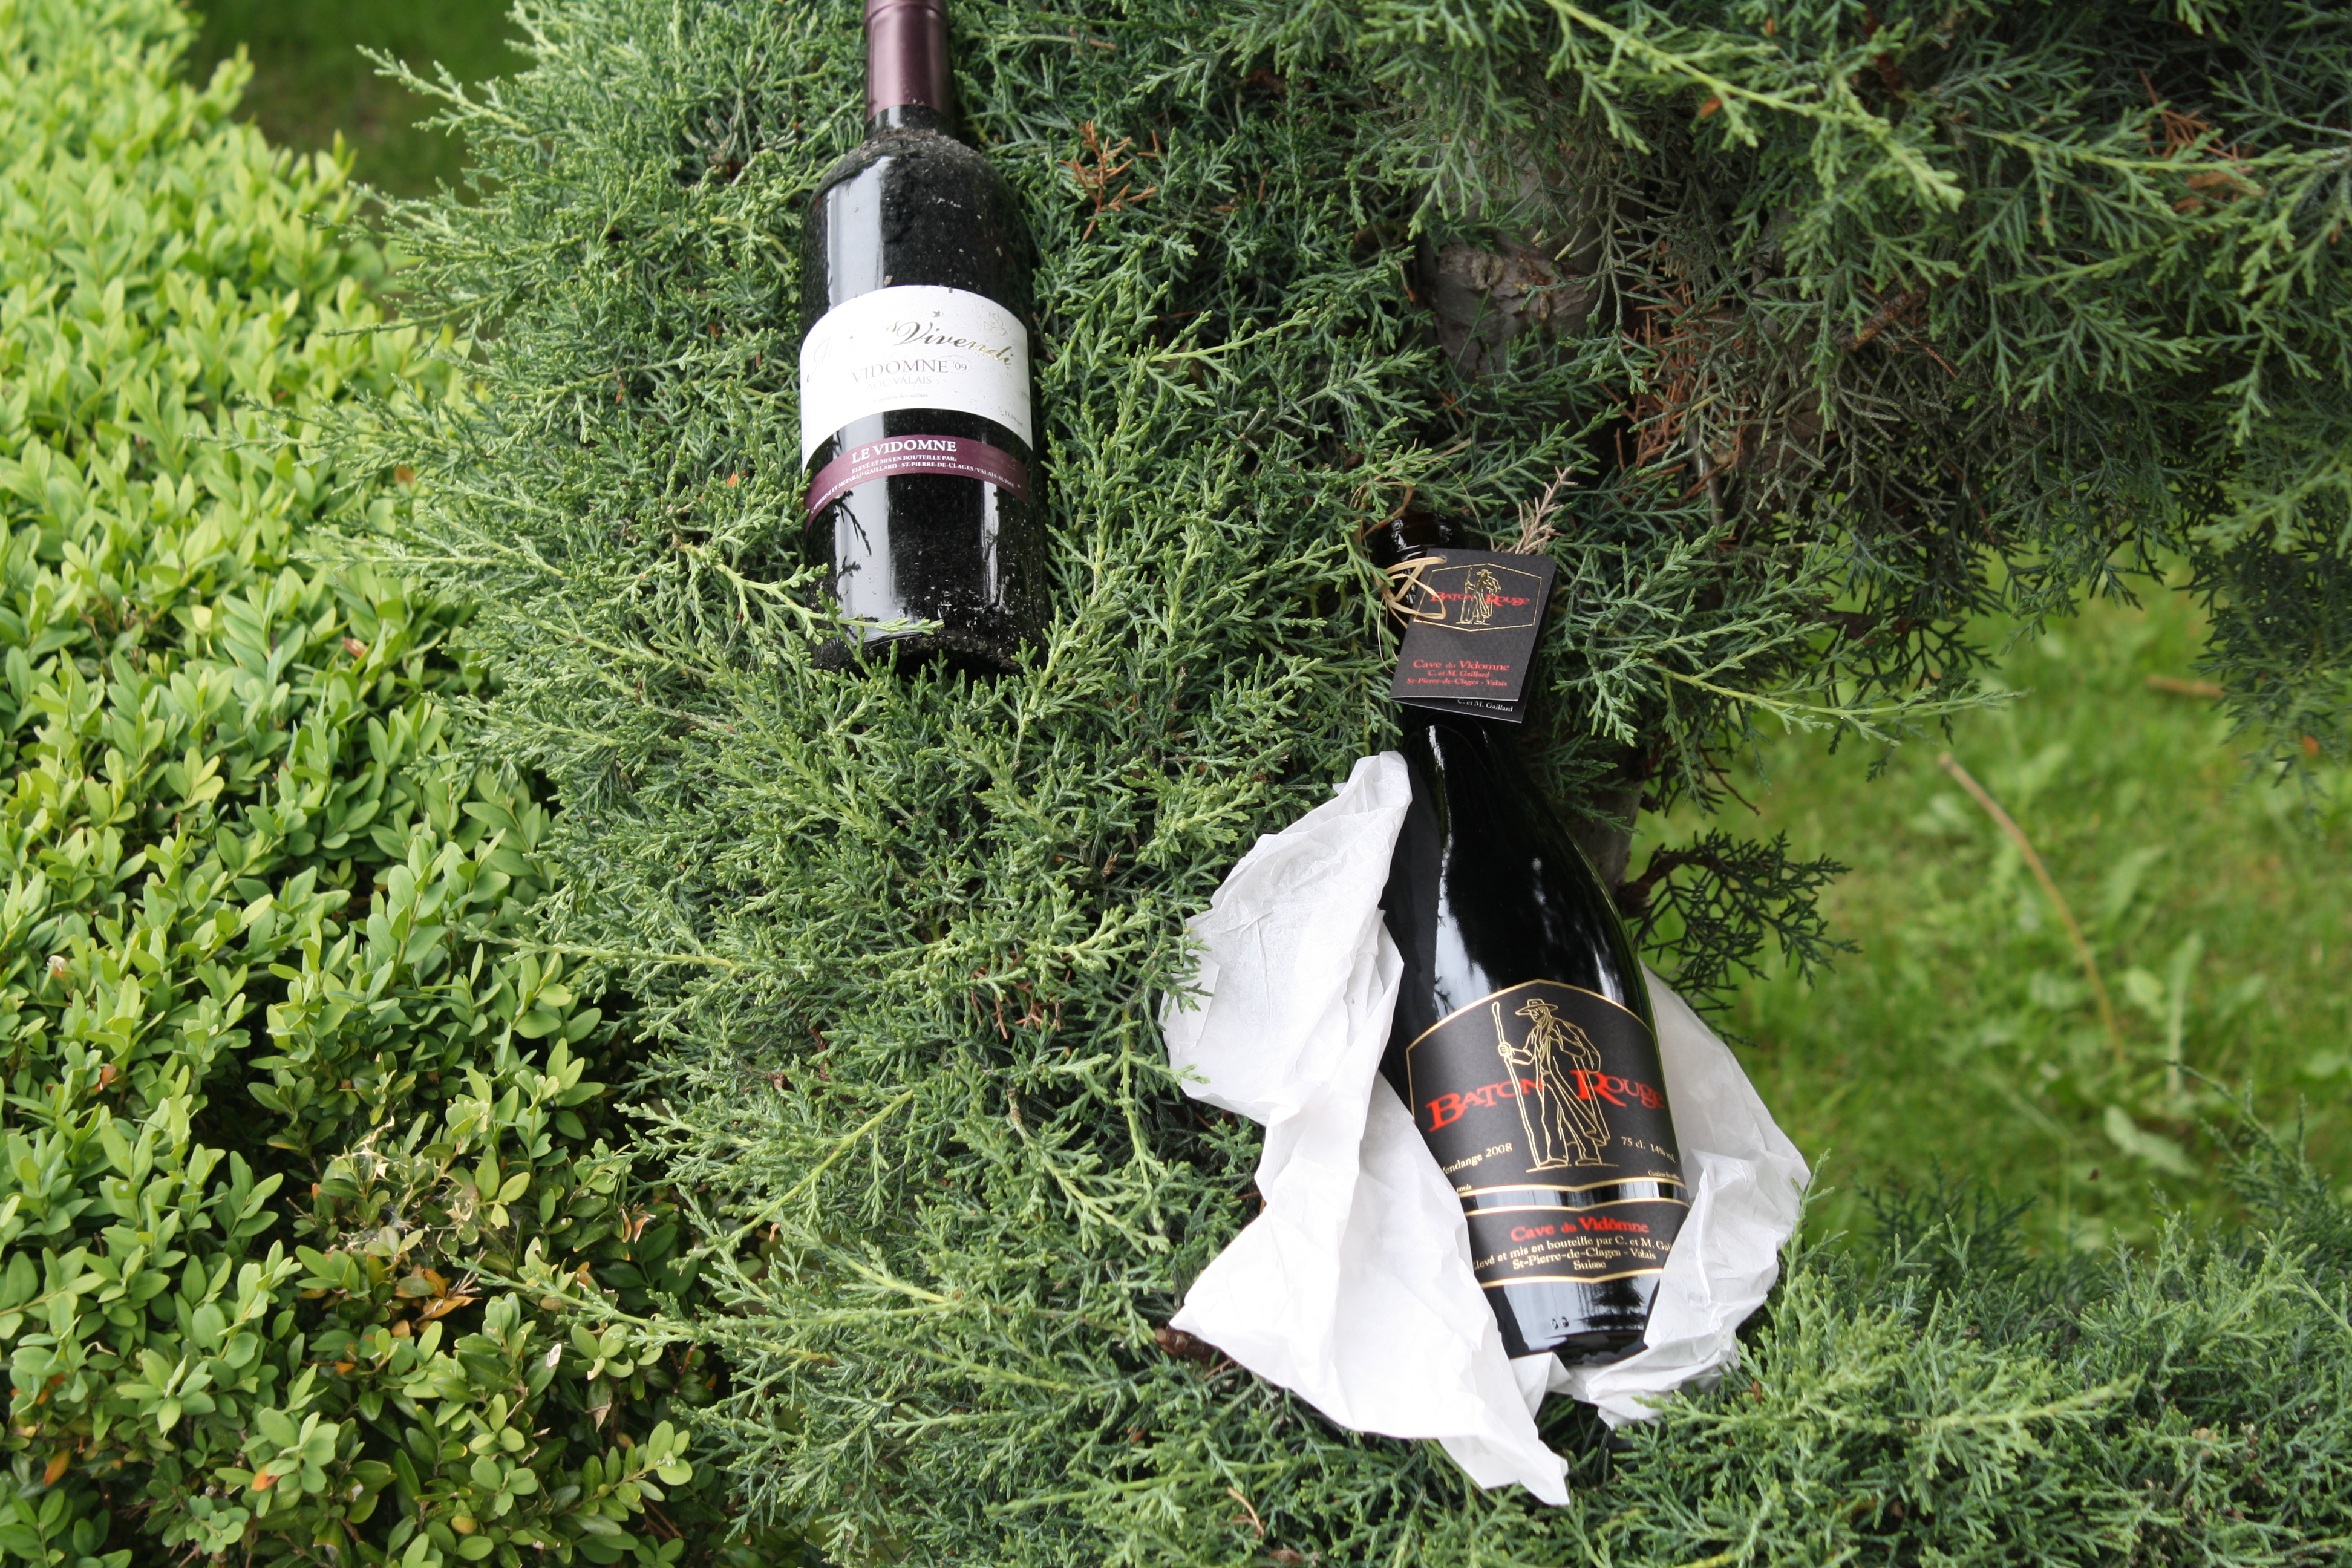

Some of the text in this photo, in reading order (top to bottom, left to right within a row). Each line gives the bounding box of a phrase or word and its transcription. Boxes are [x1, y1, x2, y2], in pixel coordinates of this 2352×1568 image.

[892, 321, 1014, 365] Vivendi
[852, 359, 967, 383] VIDOMNE '09
[866, 376, 932, 391] AOC VALAIS
[851, 439, 957, 465] LE VIDOMNE
[838, 472, 864, 488] MEINRAD
[864, 463, 897, 476] GAILLARD
[1413, 659, 1442, 668] Cave
[1459, 670, 1491, 678] Gaillard
[1406, 678, 1479, 687] St-Pierre-de-Clages
[1486, 702, 1514, 712] Gaillard
[1485, 1142, 1513, 1158] 2008
[1621, 1135, 1633, 1146] 75
[1635, 1139, 1645, 1149] cl.
[1510, 1224, 1556, 1242] Cave
[1560, 1221, 1578, 1234] du
[1497, 1251, 1508, 1263] et
[1509, 1246, 1529, 1259] mis
[1531, 1244, 1544, 1253] en
[1546, 1236, 1593, 1251] bouteille
[1596, 1237, 1613, 1247] par
[1615, 1235, 1627, 1245] C.
[1640, 1237, 1655, 1249] M.
[1512, 1247, 1621, 1270] St-Pierre-de-Clages
[1629, 1247, 1657, 1261] Valais
[1573, 1259, 1607, 1270] Suisse
